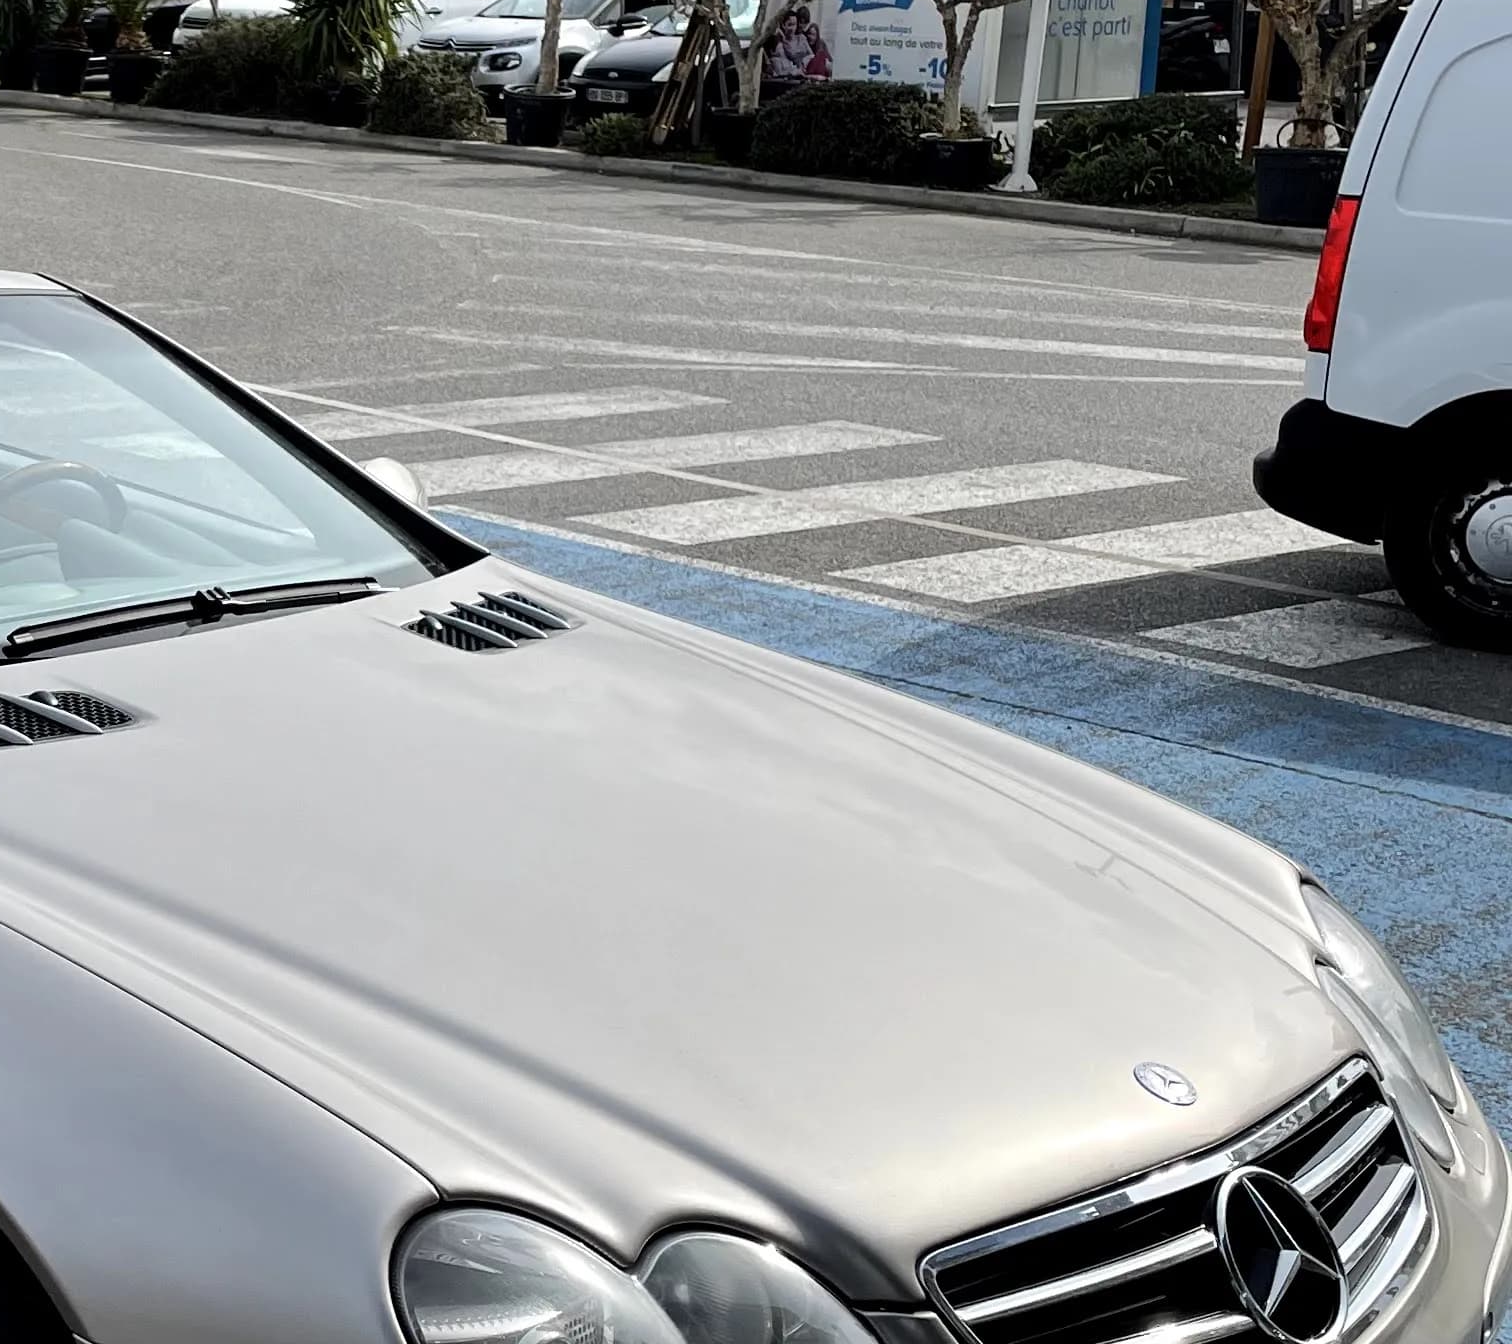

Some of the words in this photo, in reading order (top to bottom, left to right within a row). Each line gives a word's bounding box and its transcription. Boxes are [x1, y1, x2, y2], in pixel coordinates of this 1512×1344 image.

[1048, 16, 1087, 37] c'est
[1092, 15, 1132, 41] parti
[883, 37, 903, 50] long
[905, 39, 917, 49] de
[919, 40, 944, 50] votre
